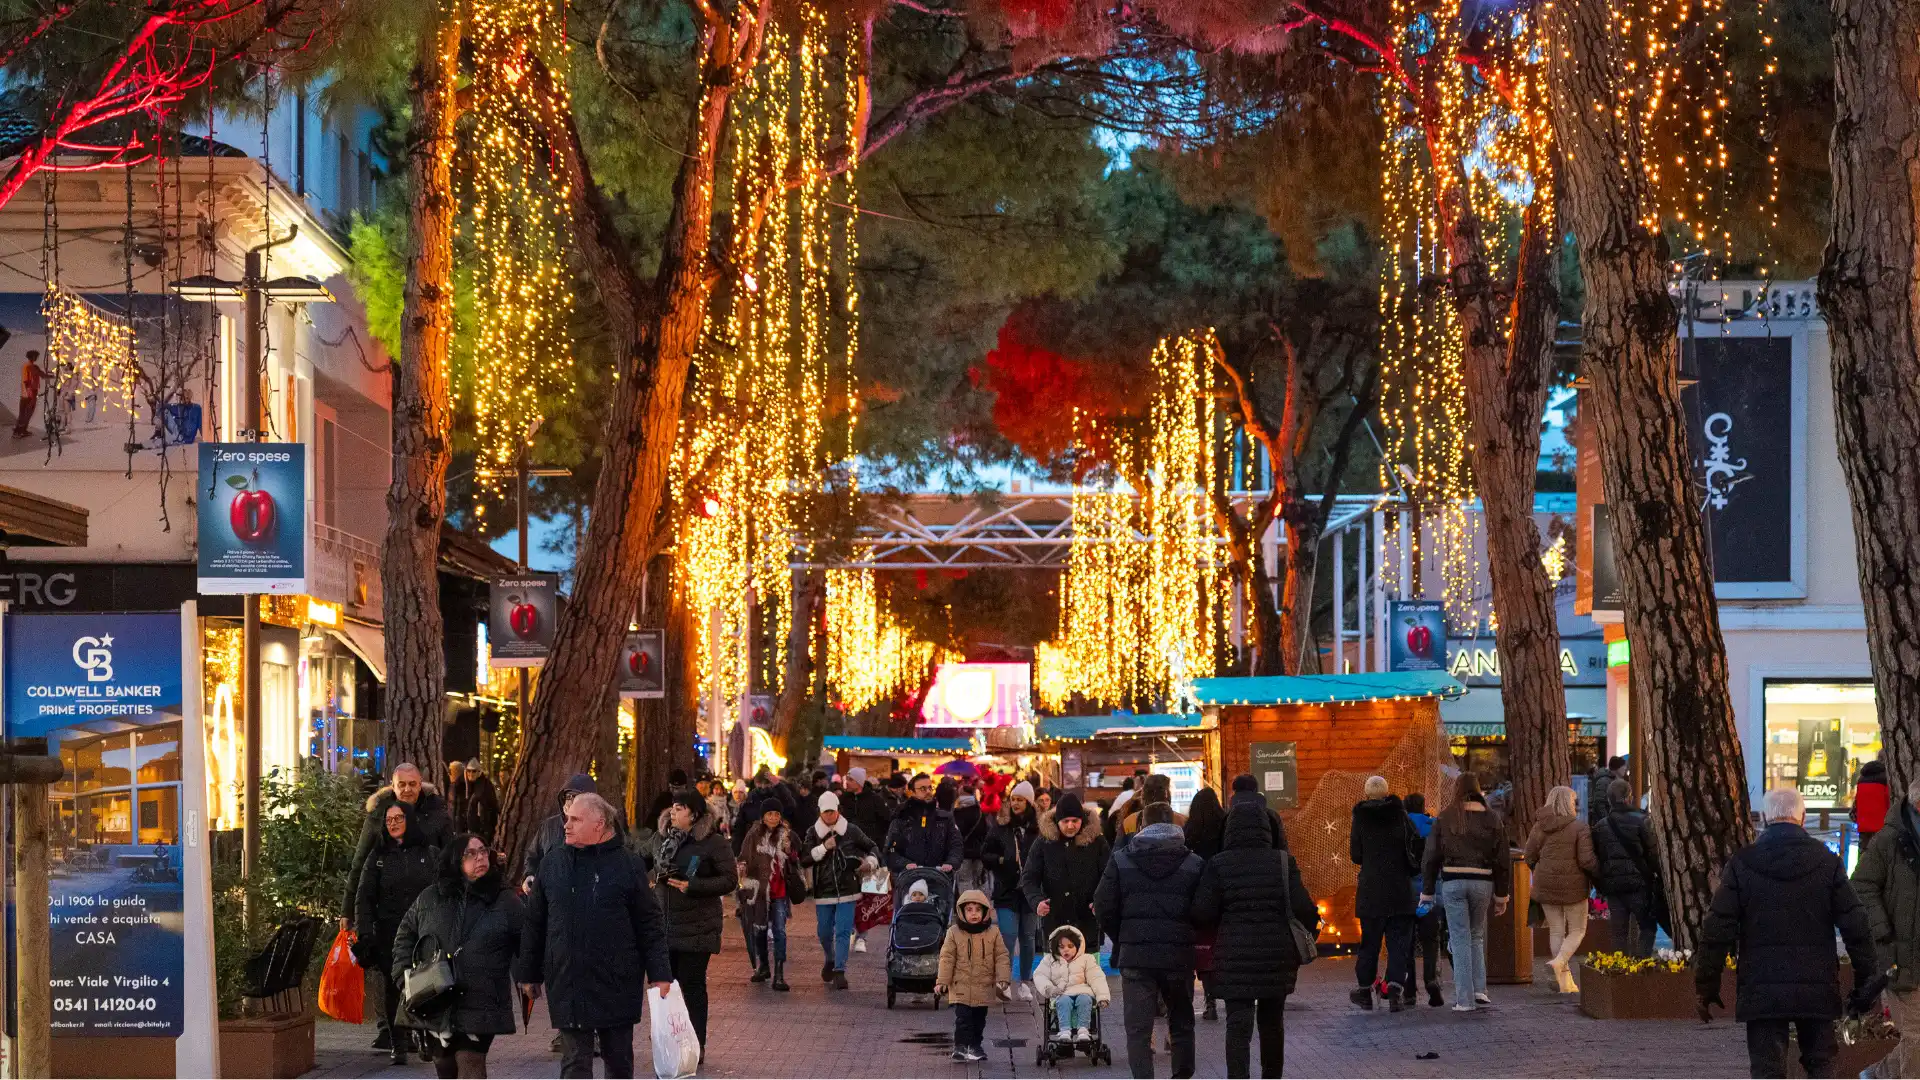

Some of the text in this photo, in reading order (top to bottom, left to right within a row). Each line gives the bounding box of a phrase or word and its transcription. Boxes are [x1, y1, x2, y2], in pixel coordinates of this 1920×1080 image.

[212, 449, 290, 464] Zero spese
[499, 579, 547, 588] Zero spese
[1398, 604, 1416, 612] Zero
[27, 685, 161, 697] COLDWELL BANKER
[39, 704, 153, 715] PRIME PROPERTIES
[1797, 785, 1837, 796] LIERAC
[69, 896, 94, 906] 1906
[98, 895, 108, 906] la
[113, 895, 146, 908] guida
[49, 911, 161, 926] hi vende e acquista
[75, 932, 116, 945] CASA
[49, 976, 170, 990] one: Viale Virgilio 4
[54, 998, 157, 1011] 0541 1412040
